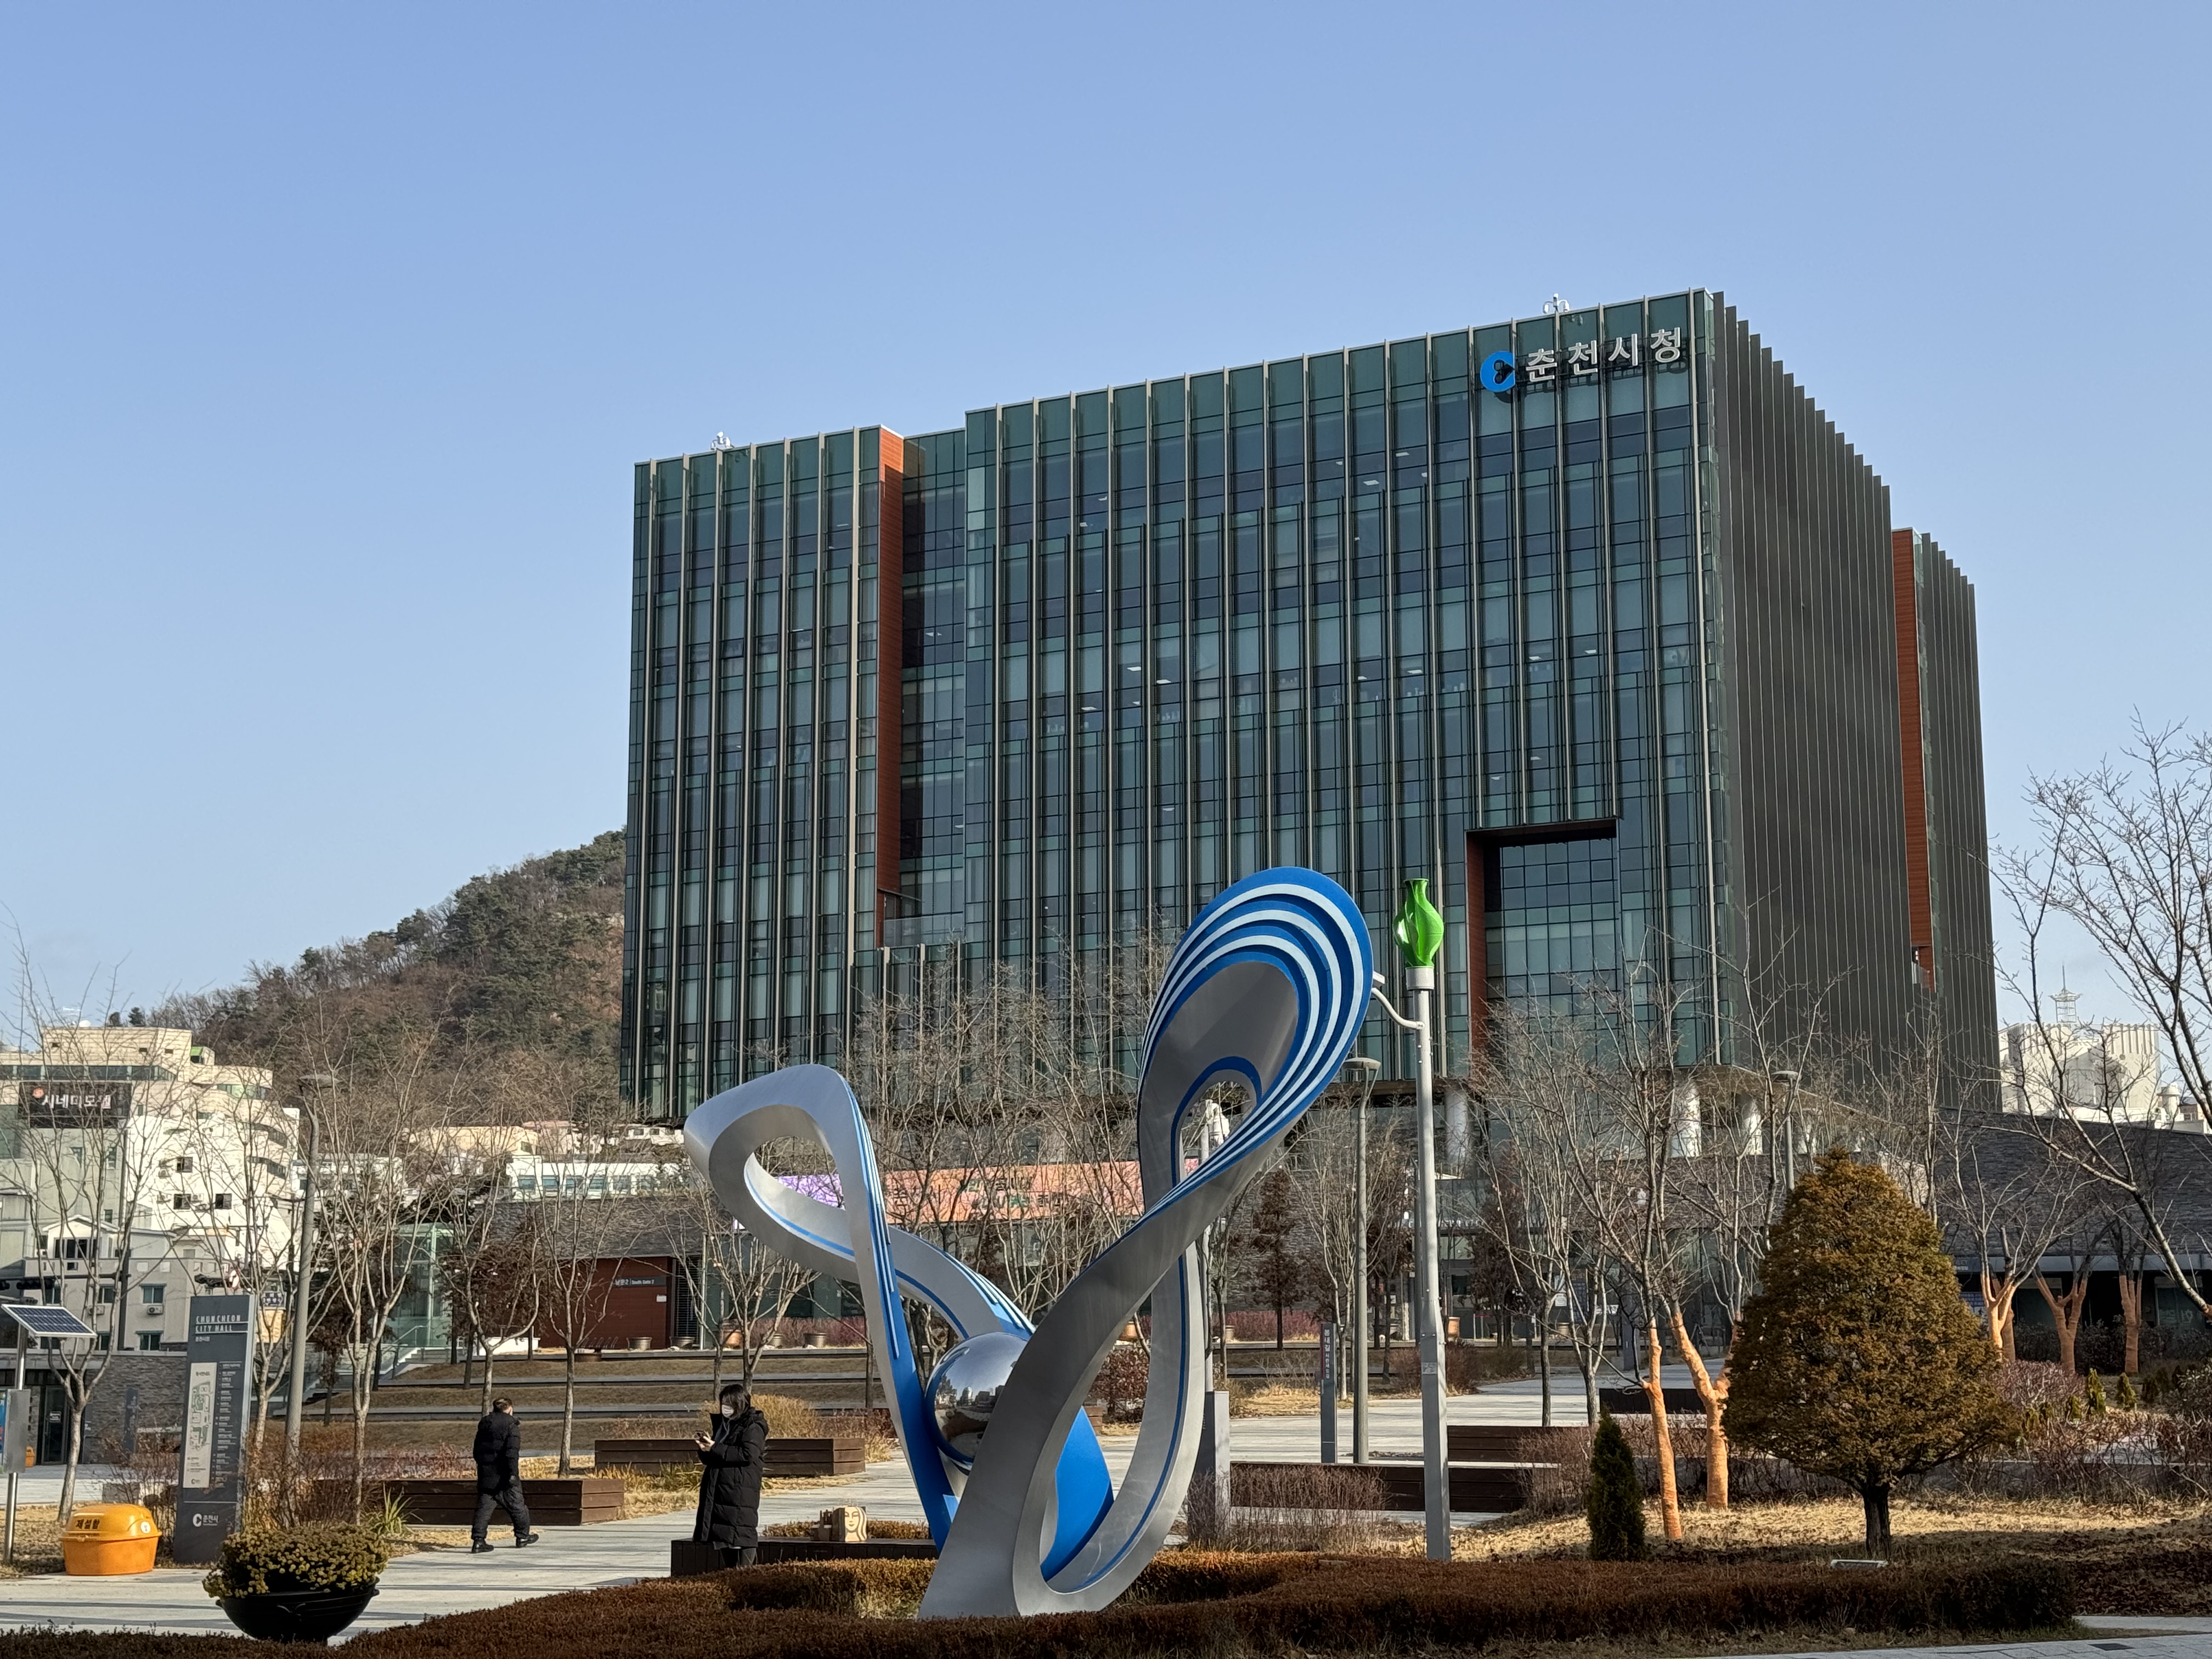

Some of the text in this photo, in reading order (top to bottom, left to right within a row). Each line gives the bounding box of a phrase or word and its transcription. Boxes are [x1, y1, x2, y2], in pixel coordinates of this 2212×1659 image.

[1526, 327, 1680, 382] 춘천시청
[196, 1314, 240, 1323] CHUNCHEON
[76, 1518, 100, 1530] 제설함
